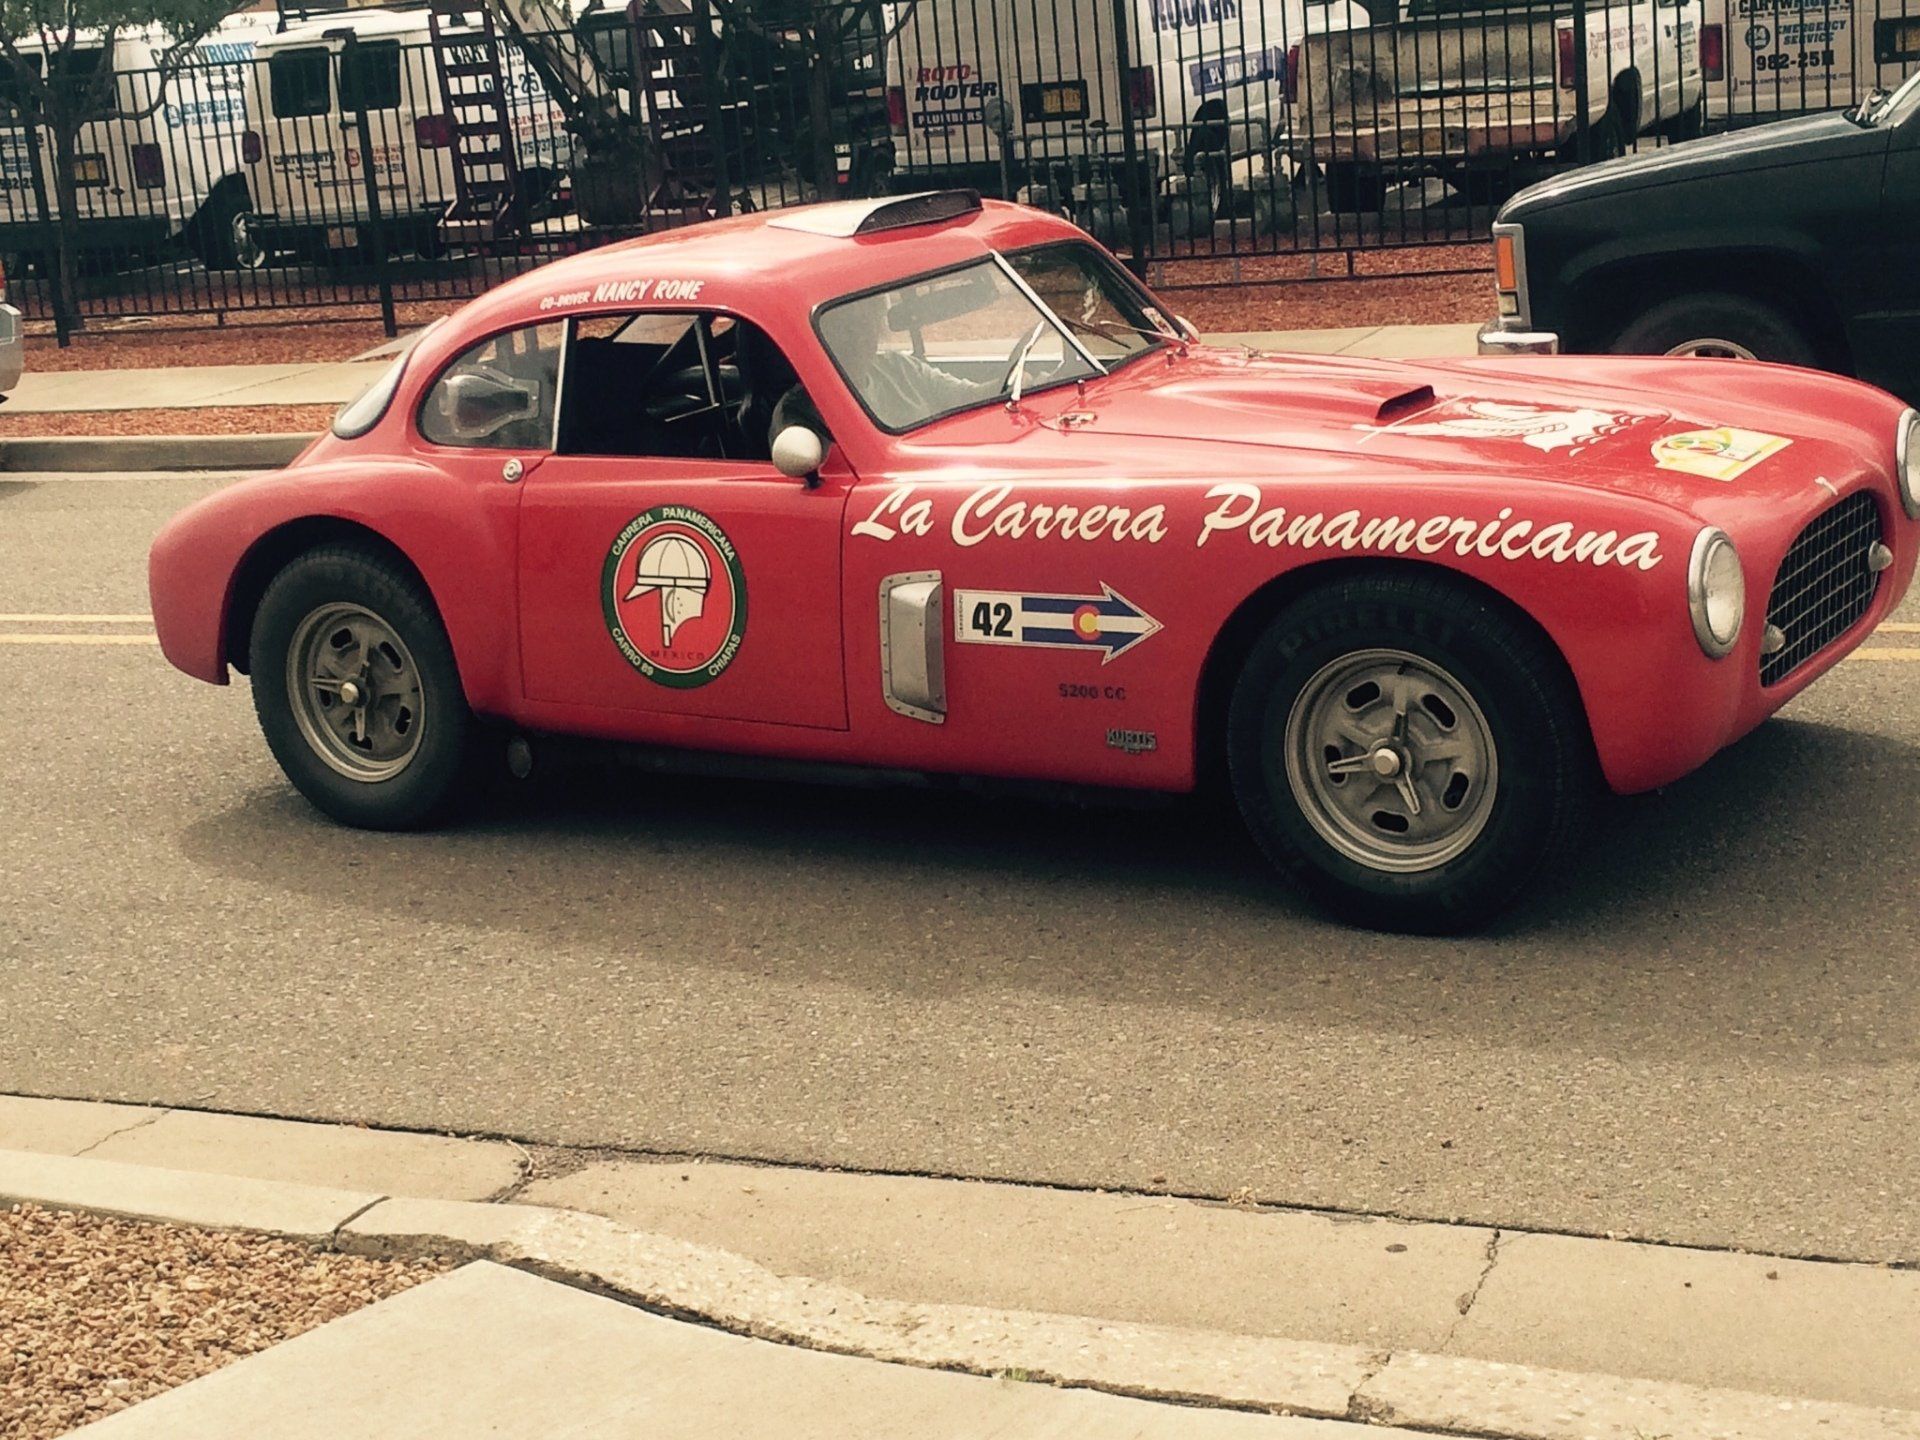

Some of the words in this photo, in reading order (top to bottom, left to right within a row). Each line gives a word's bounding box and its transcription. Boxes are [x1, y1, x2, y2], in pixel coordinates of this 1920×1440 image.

[916, 65, 978, 83] ROTO-
[1208, 58, 1258, 85] PLMBRS
[915, 82, 998, 101] ROOTER
[539, 291, 591, 310] CO-DRIVER
[592, 278, 653, 303] NANCY
[652, 279, 705, 301] ROME
[611, 512, 654, 556] CARRERA
[662, 507, 736, 562] PANAMERICANA
[851, 484, 935, 541] La
[950, 482, 1168, 547] Carrera
[1197, 482, 1664, 571] Panamericana
[972, 602, 1013, 638] 42
[611, 627, 641, 666] CARRO
[651, 650, 706, 661] MEXICO
[708, 633, 741, 677] CHIAPAS
[1058, 684, 1098, 699] 5200
[1103, 686, 1127, 700] CC
